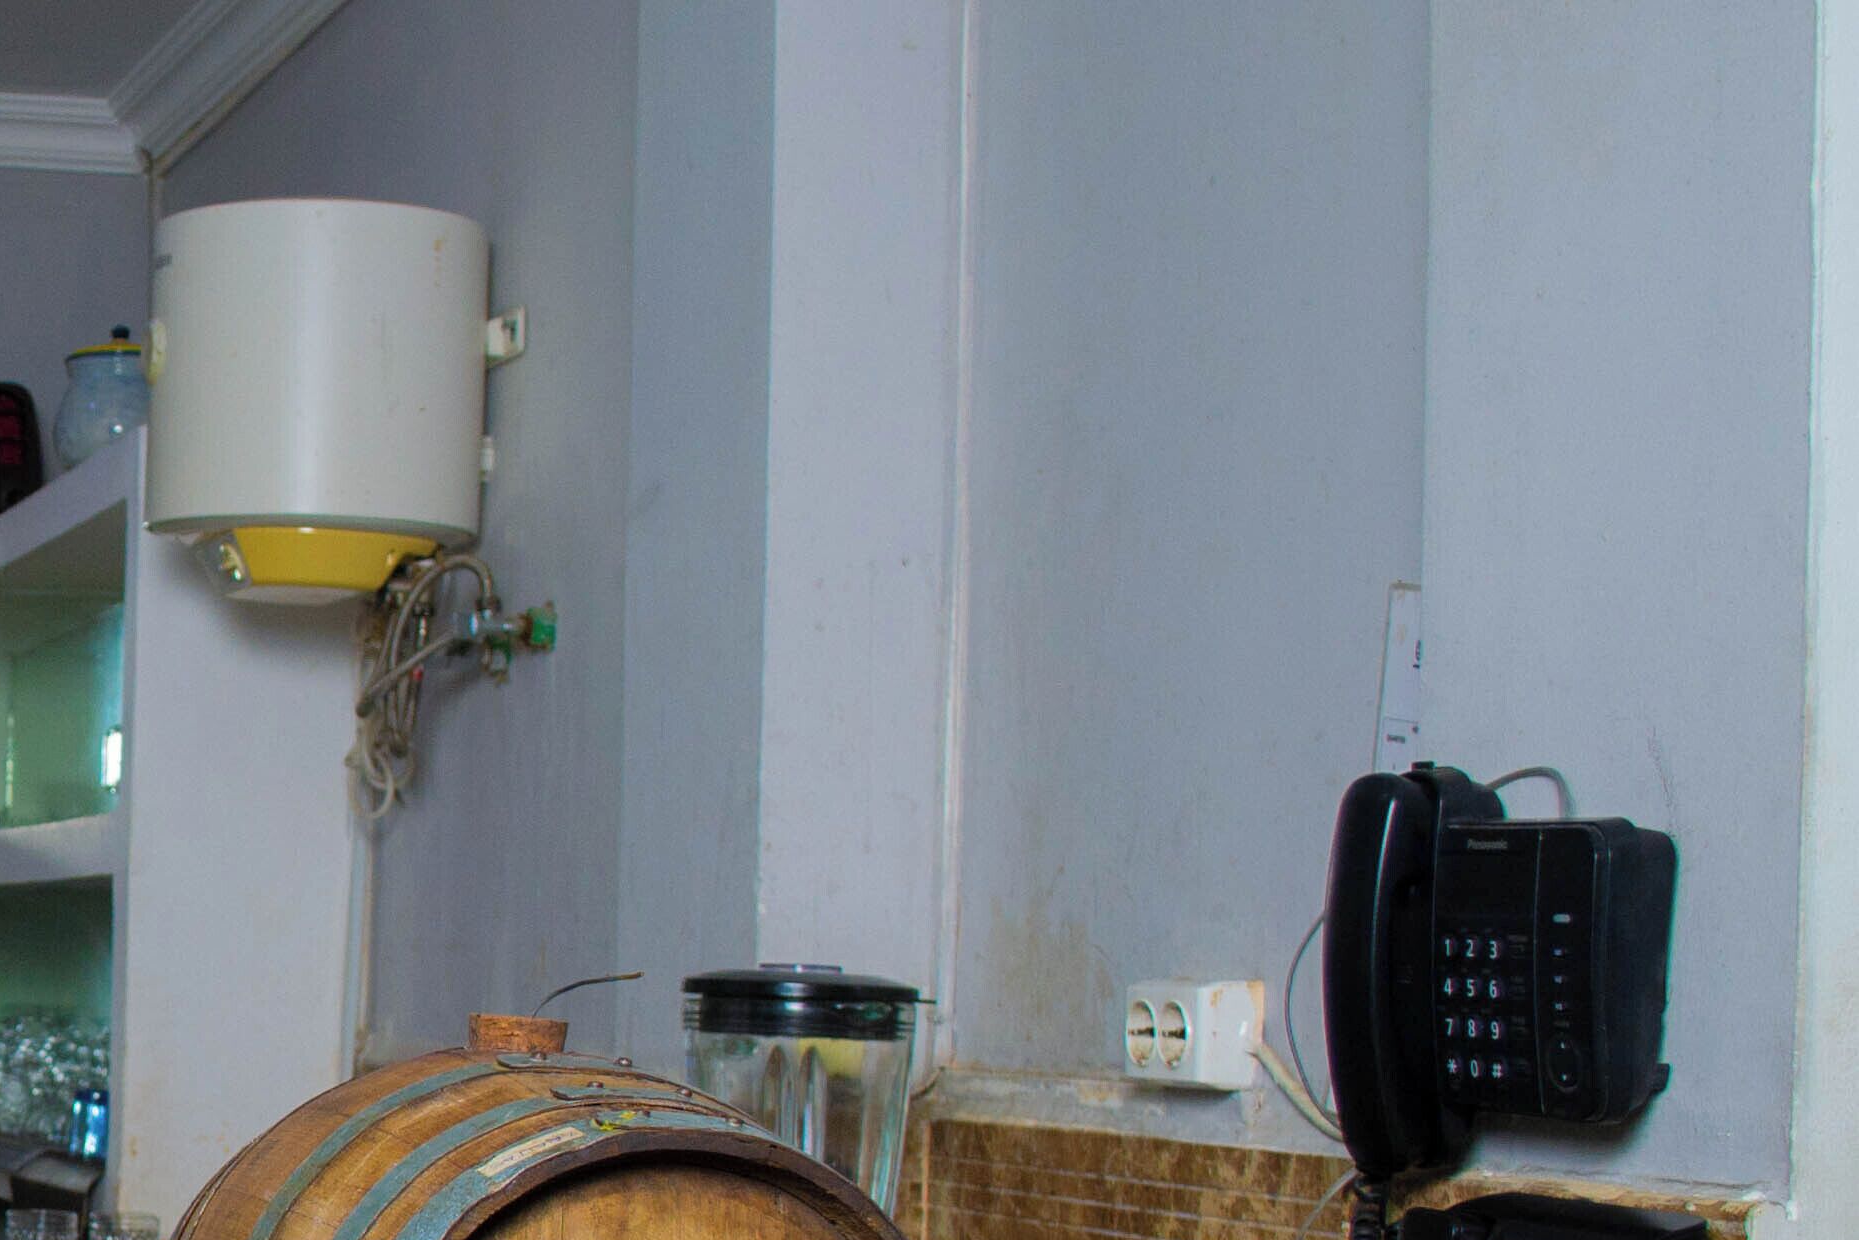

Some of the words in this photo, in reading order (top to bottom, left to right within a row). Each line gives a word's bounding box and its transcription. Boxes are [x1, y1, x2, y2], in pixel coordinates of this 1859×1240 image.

[1444, 938, 1451, 958] 1
[1465, 938, 1475, 958] 2
[1488, 939, 1498, 960] 3
[1443, 977, 1453, 997] 4
[1465, 977, 1475, 998] 5
[1488, 978, 1499, 999] 6
[1445, 1017, 1454, 1037] 7
[1467, 1018, 1477, 1039] 8
[1490, 1020, 1499, 1041] 9
[1470, 1058, 1479, 1080] 0
